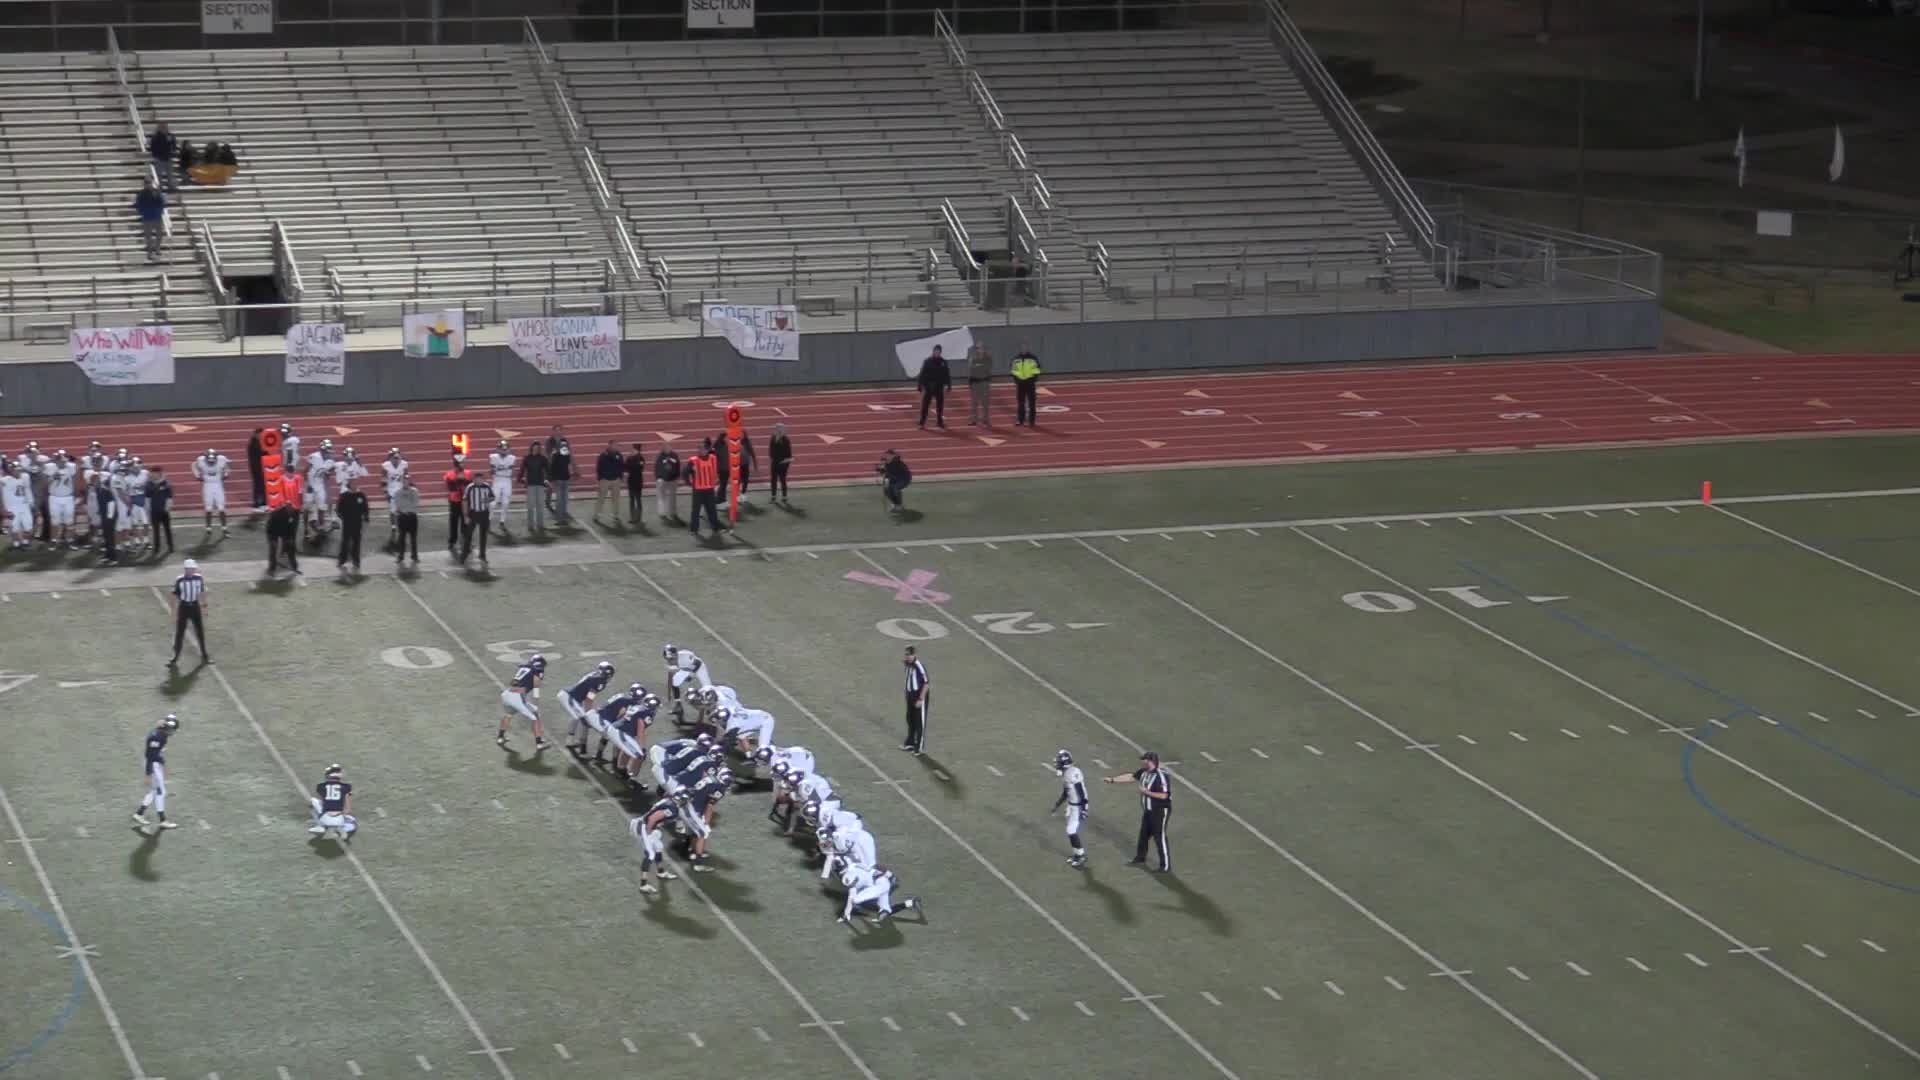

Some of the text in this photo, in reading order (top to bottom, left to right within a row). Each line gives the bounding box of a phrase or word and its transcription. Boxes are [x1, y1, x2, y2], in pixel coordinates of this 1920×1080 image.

[205, 3, 270, 16] SECTION
[691, 0, 752, 10] SECTION
[231, 16, 246, 31] K
[717, 11, 726, 25] L
[452, 433, 471, 455] 4
[325, 784, 342, 800] 16
